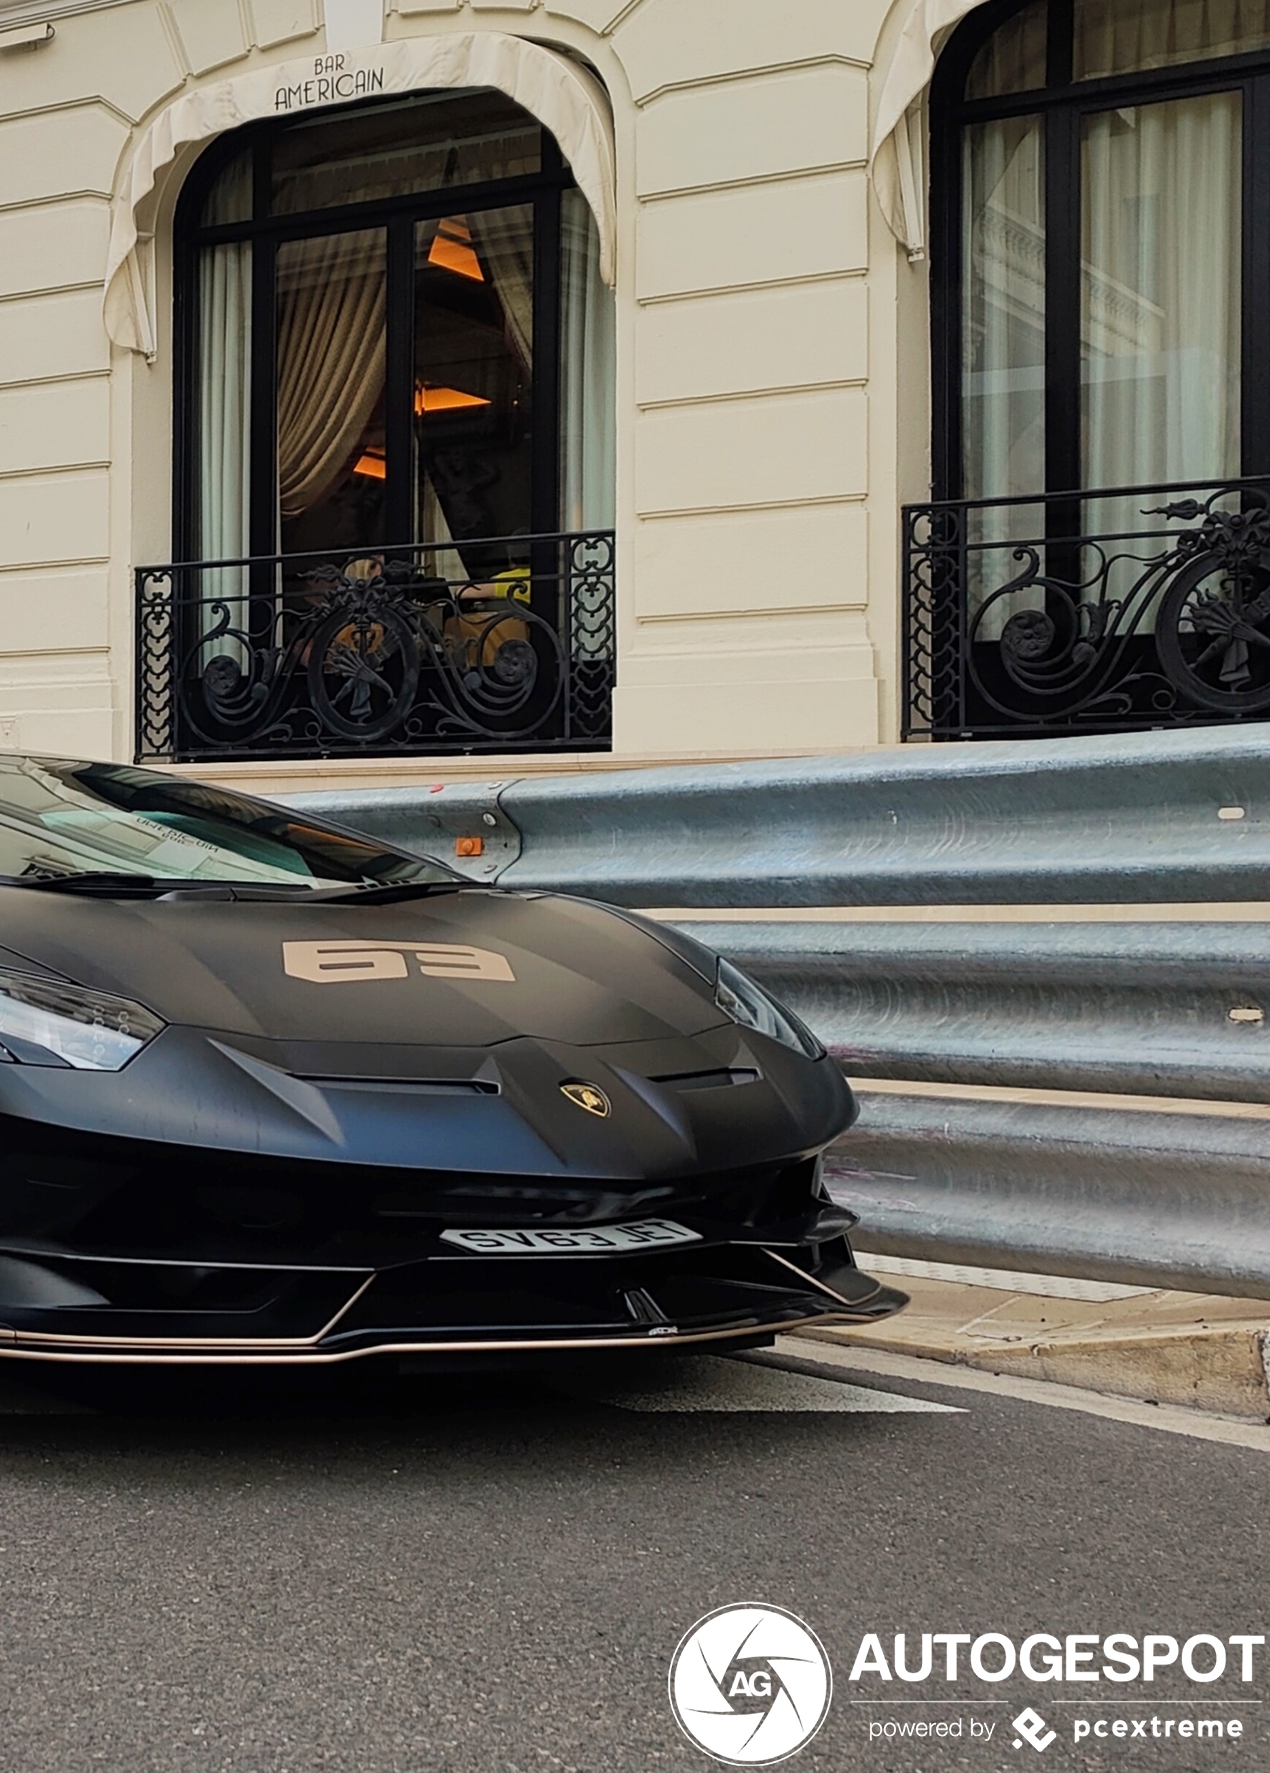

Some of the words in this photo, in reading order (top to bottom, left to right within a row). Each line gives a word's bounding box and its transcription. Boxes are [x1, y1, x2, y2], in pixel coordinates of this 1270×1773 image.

[314, 54, 345, 75] BAR
[275, 67, 384, 110] AMERICAIN
[282, 939, 516, 984] 63
[459, 1232, 617, 1247] SV63
[615, 1221, 688, 1243] JET
